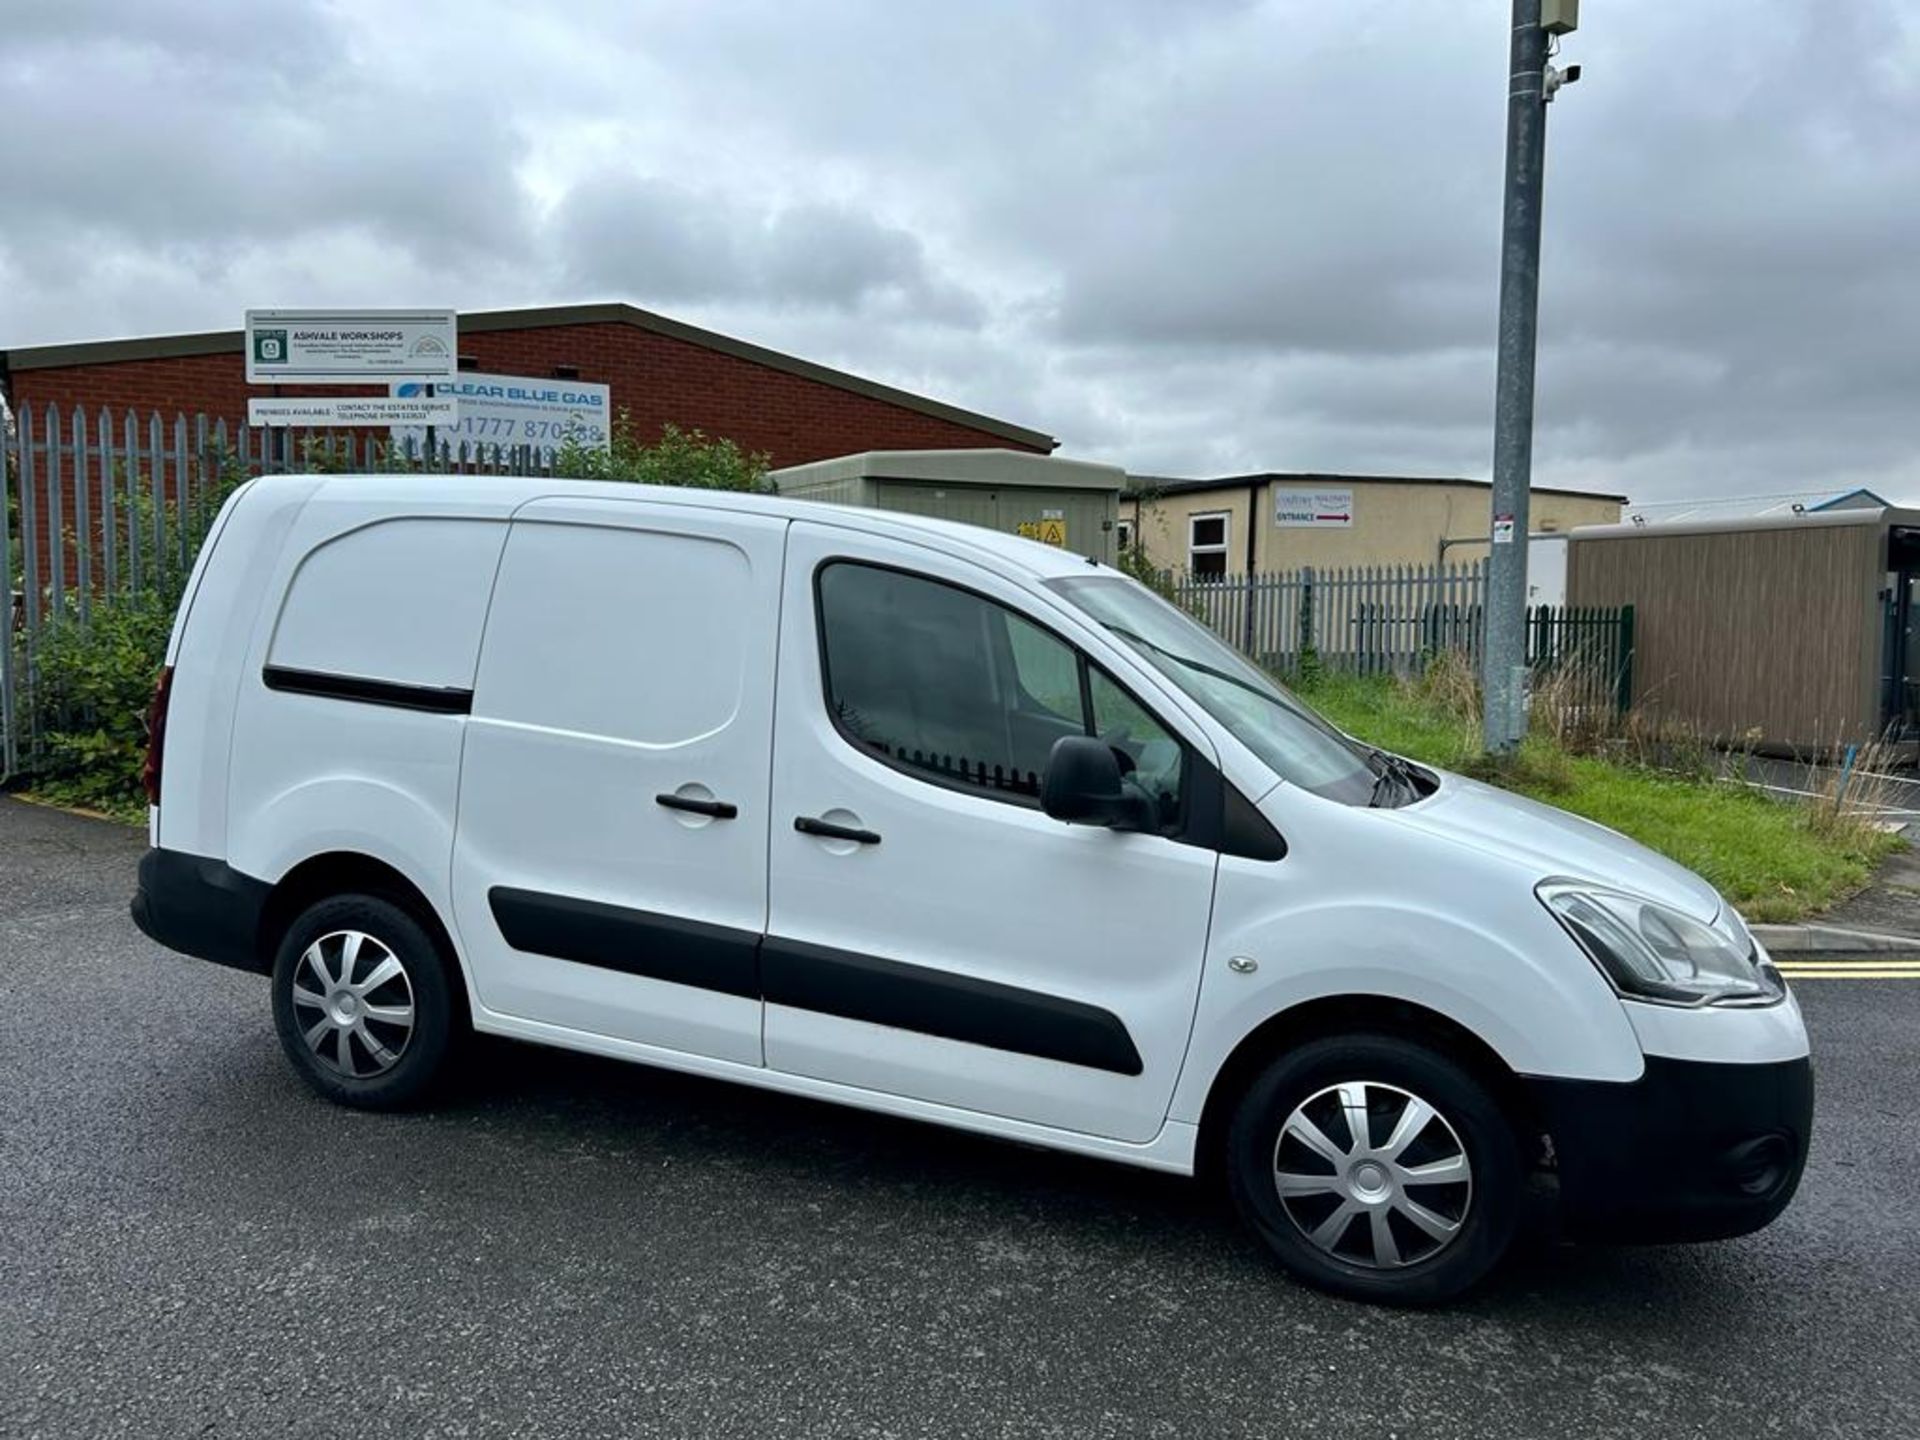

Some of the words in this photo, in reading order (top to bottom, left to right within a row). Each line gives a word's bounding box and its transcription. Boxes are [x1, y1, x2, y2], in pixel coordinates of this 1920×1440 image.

[293, 331, 337, 340] ASHVALE
[340, 331, 403, 340] WORKSHOPS
[436, 383, 504, 398] CLEAR
[507, 387, 559, 400] BLUE
[562, 393, 603, 406] GAS
[292, 408, 330, 416] AVAILABLE
[524, 420, 600, 441] 87088
[1276, 512, 1315, 521] ENTRANCE
